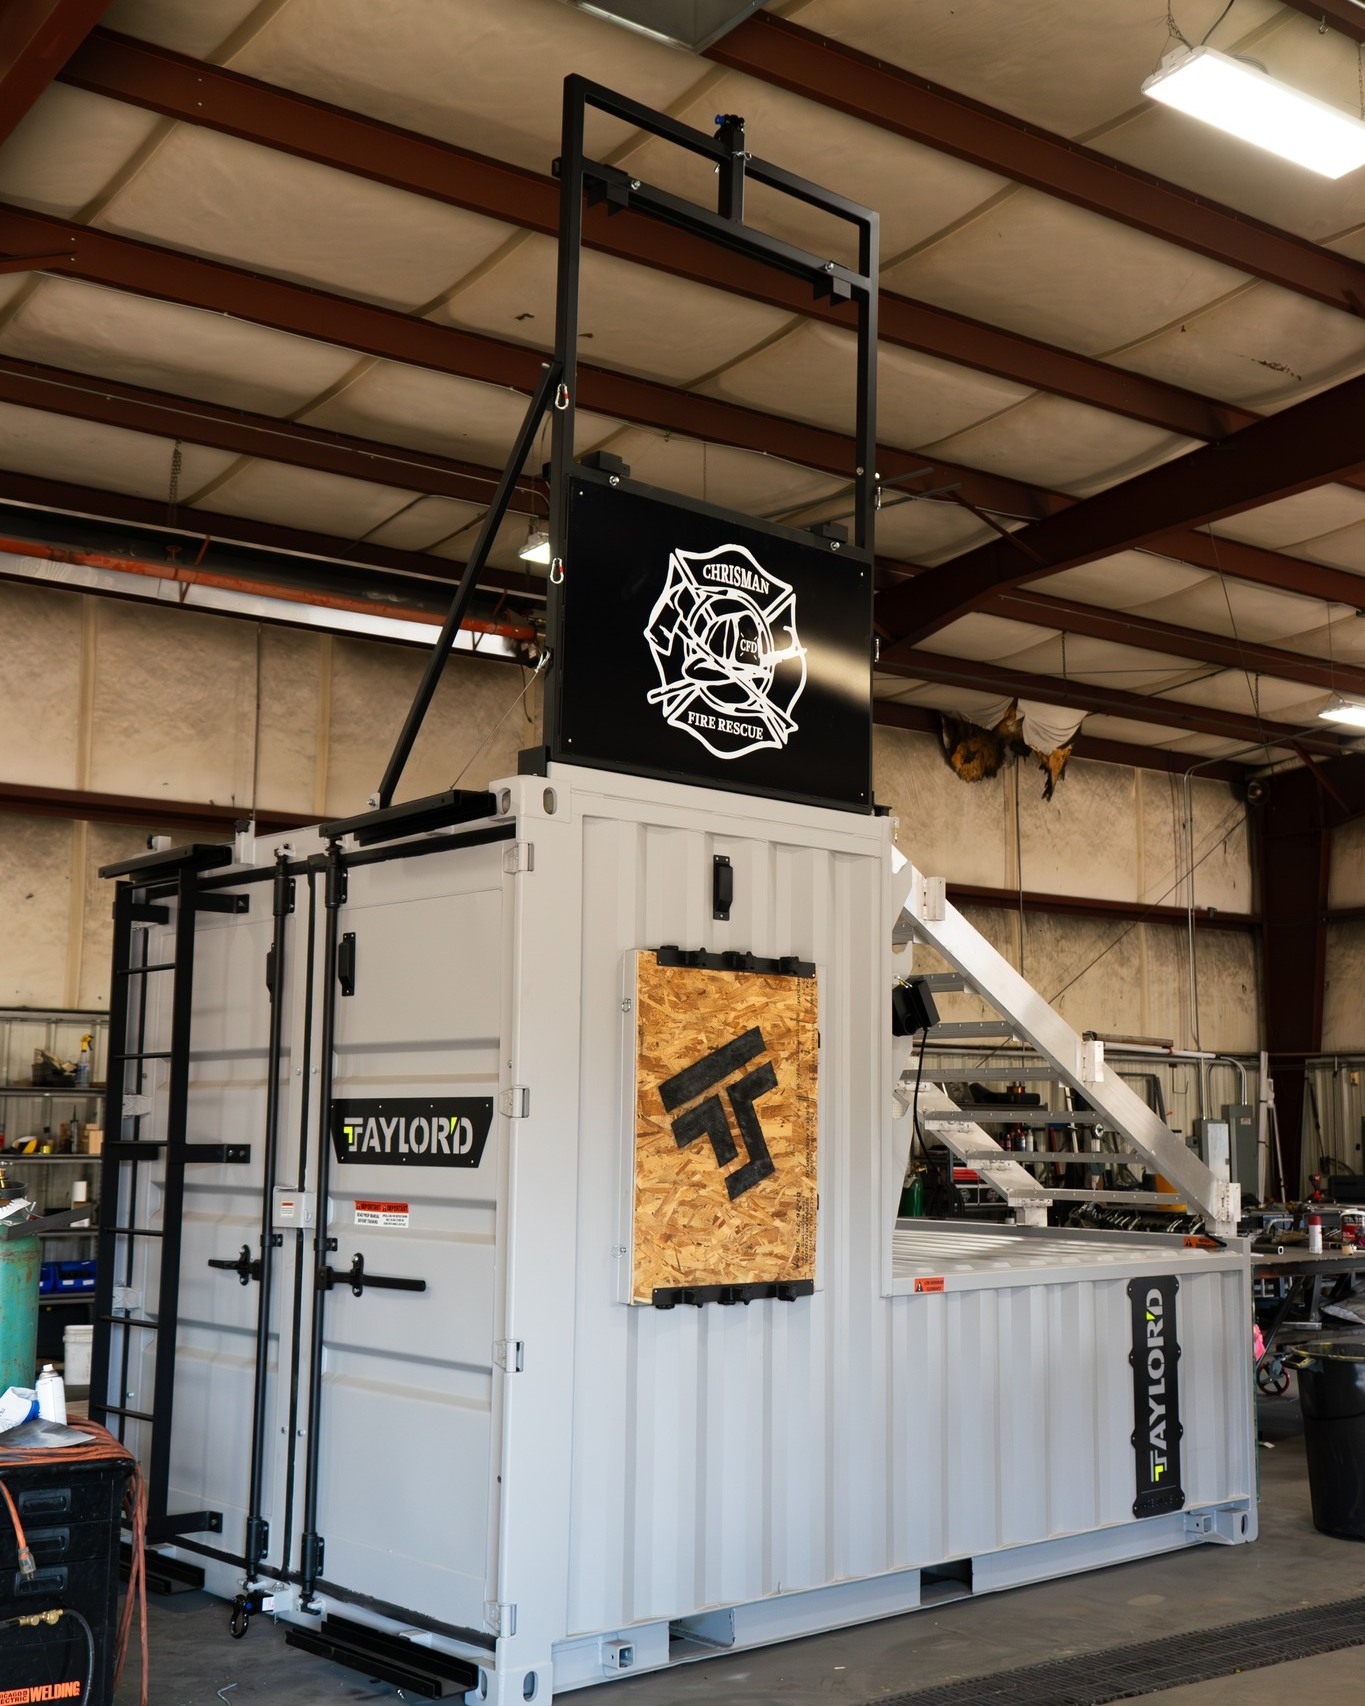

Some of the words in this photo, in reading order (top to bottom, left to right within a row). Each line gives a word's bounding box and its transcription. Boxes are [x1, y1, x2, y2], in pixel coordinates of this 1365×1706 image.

[703, 564, 769, 594] CHRISMAN
[740, 638, 757, 653] CFD
[688, 711, 715, 730] FIRE
[717, 717, 764, 740] RESCUE
[0, 1690, 23, 1699] ICAGO
[30, 1681, 80, 1702] WELDING
